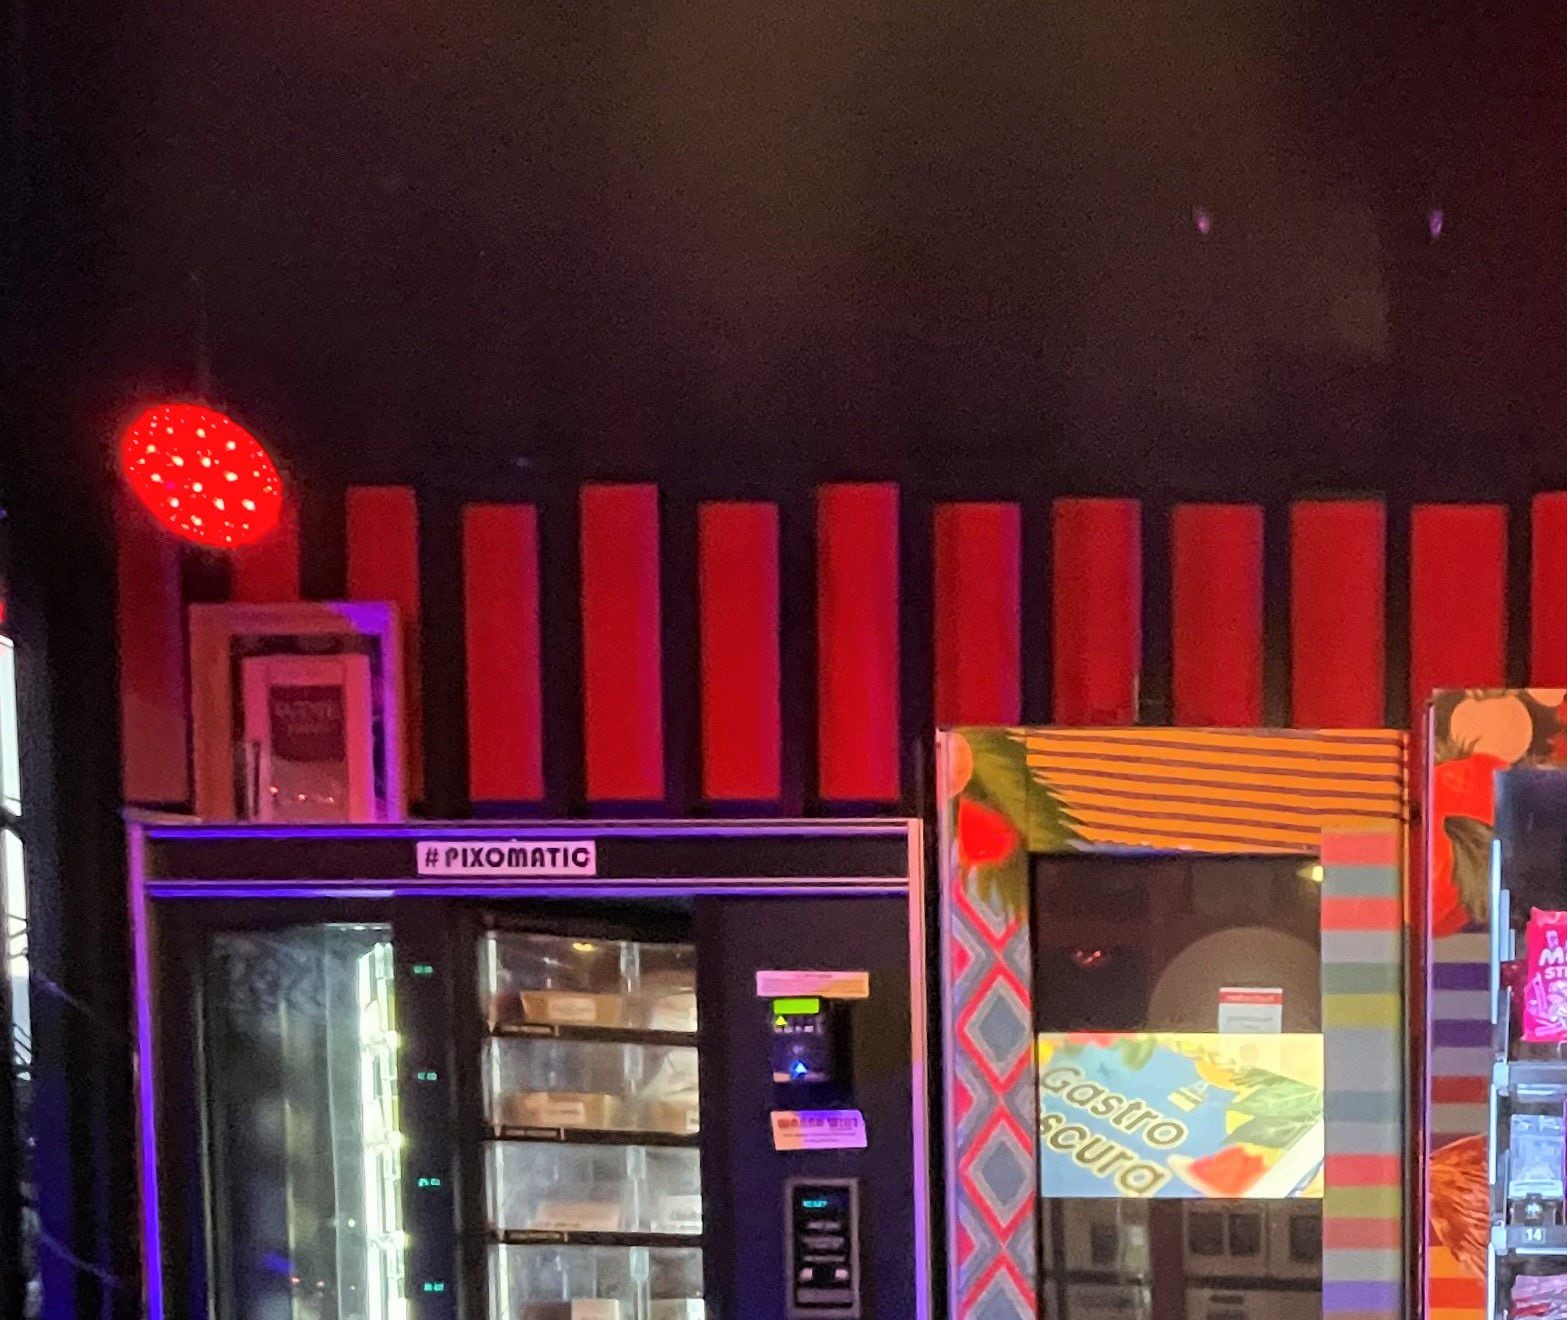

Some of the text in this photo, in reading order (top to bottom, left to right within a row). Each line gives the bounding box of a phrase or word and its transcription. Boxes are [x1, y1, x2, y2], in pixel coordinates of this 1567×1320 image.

[425, 847, 591, 868] #PIXOMATIC
[1041, 1066, 1186, 1147] Gastro
[1525, 1228, 1542, 1241] 14
